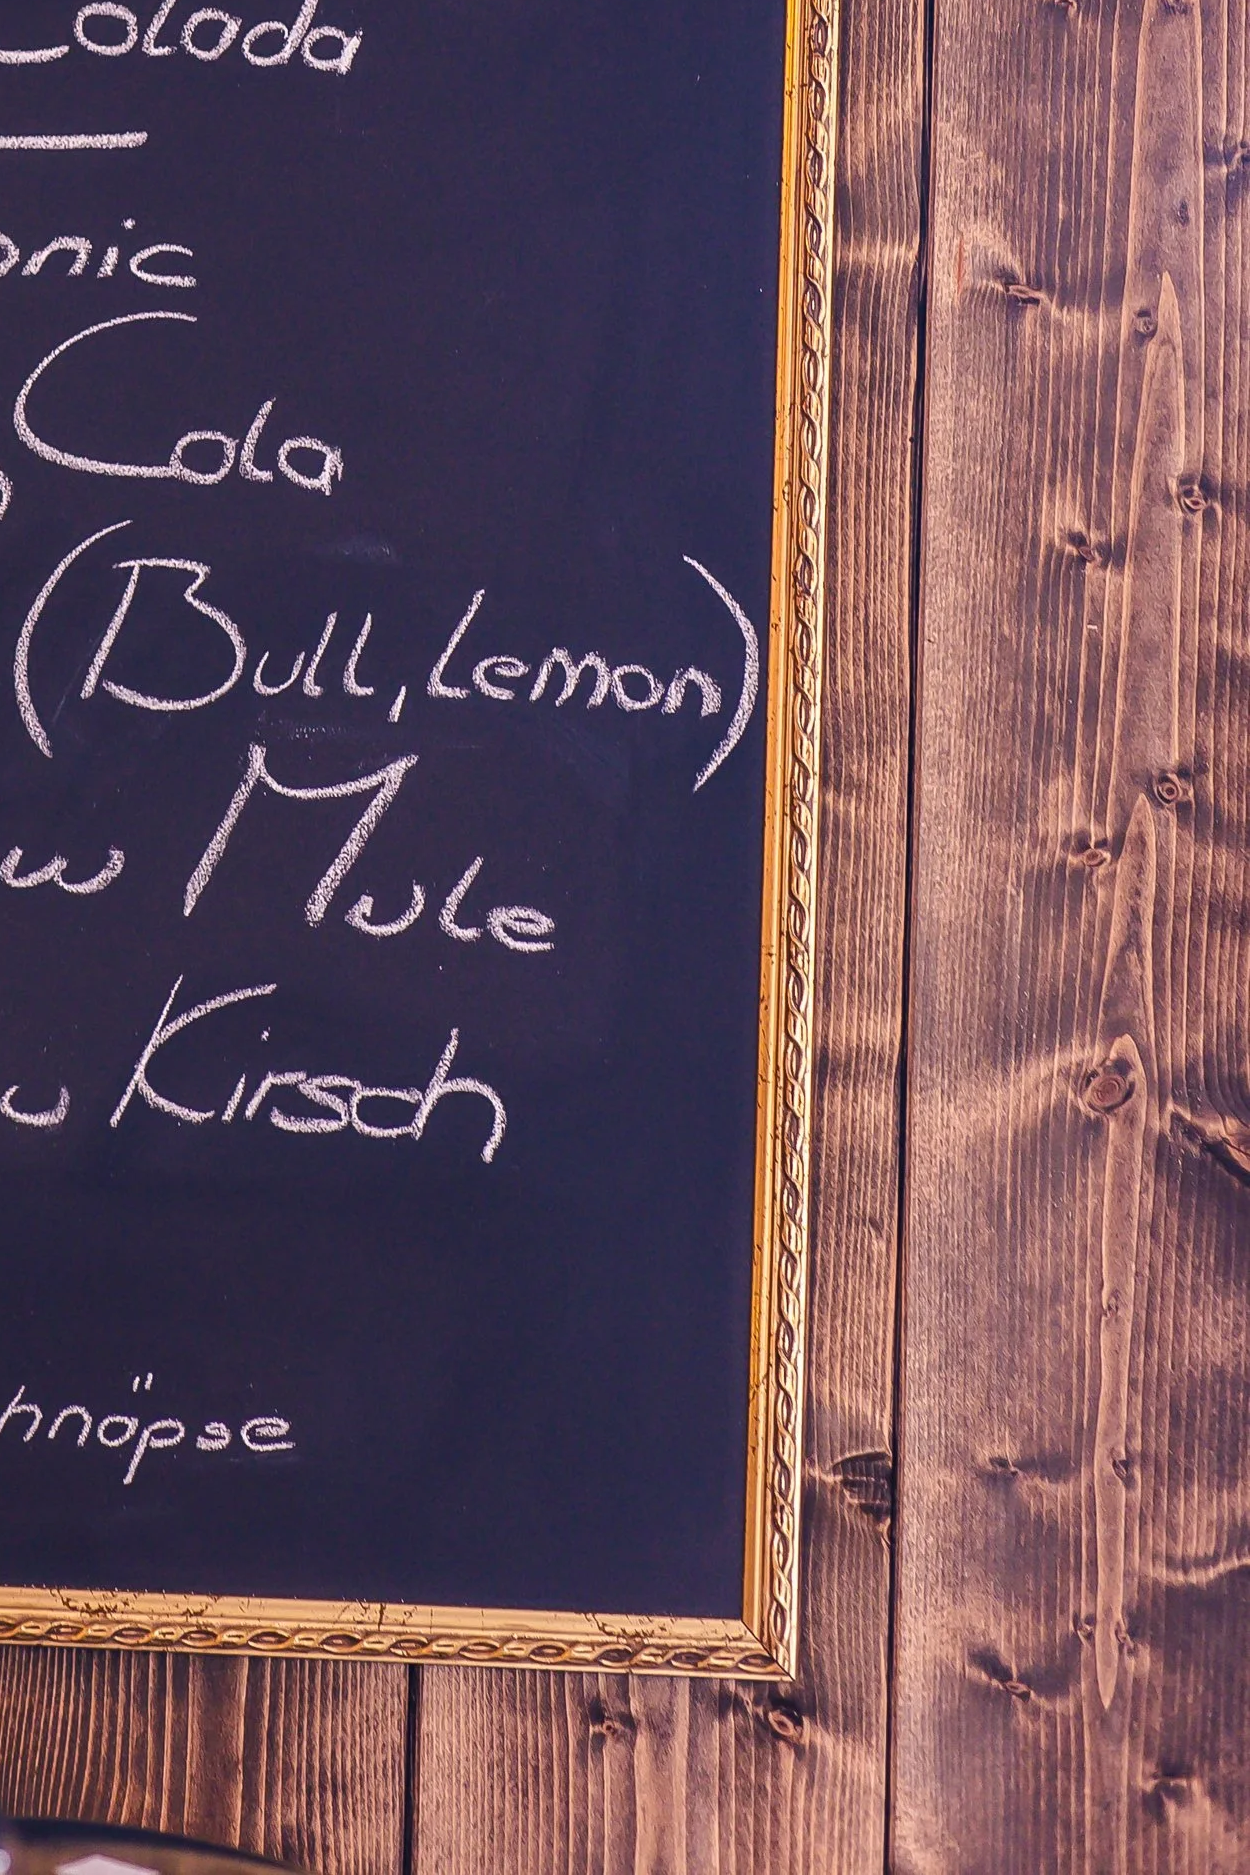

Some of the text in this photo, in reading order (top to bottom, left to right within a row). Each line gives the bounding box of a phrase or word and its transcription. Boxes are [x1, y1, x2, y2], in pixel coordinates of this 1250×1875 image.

[13, 309, 345, 498] Cola
[182, 739, 556, 954] Mule
[109, 972, 509, 1164] Kirsch
